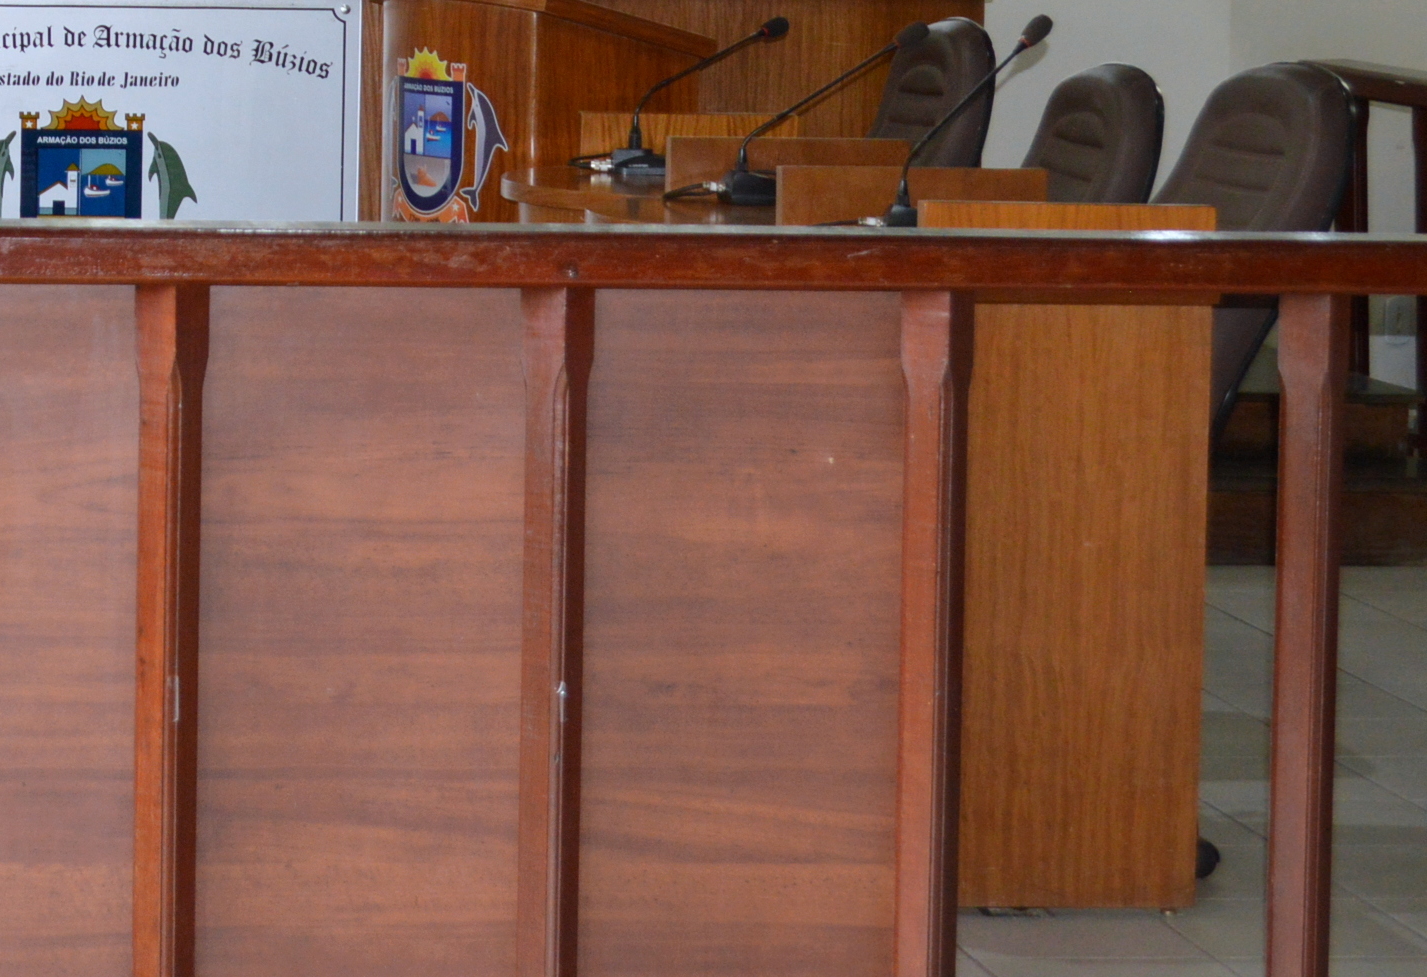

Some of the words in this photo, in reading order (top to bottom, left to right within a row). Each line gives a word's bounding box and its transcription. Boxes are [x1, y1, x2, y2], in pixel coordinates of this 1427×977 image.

[63, 25, 87, 48] de
[92, 24, 194, 59] Armação
[202, 33, 243, 59] dos
[249, 39, 334, 80] Búzios
[45, 70, 64, 86] do
[69, 71, 95, 87] Rio
[97, 71, 115, 87] de
[119, 71, 180, 89] Janeiro
[36, 134, 78, 145] ARMAÇÃO
[79, 136, 97, 144] DOS
[98, 134, 128, 145] BÚZIOS
